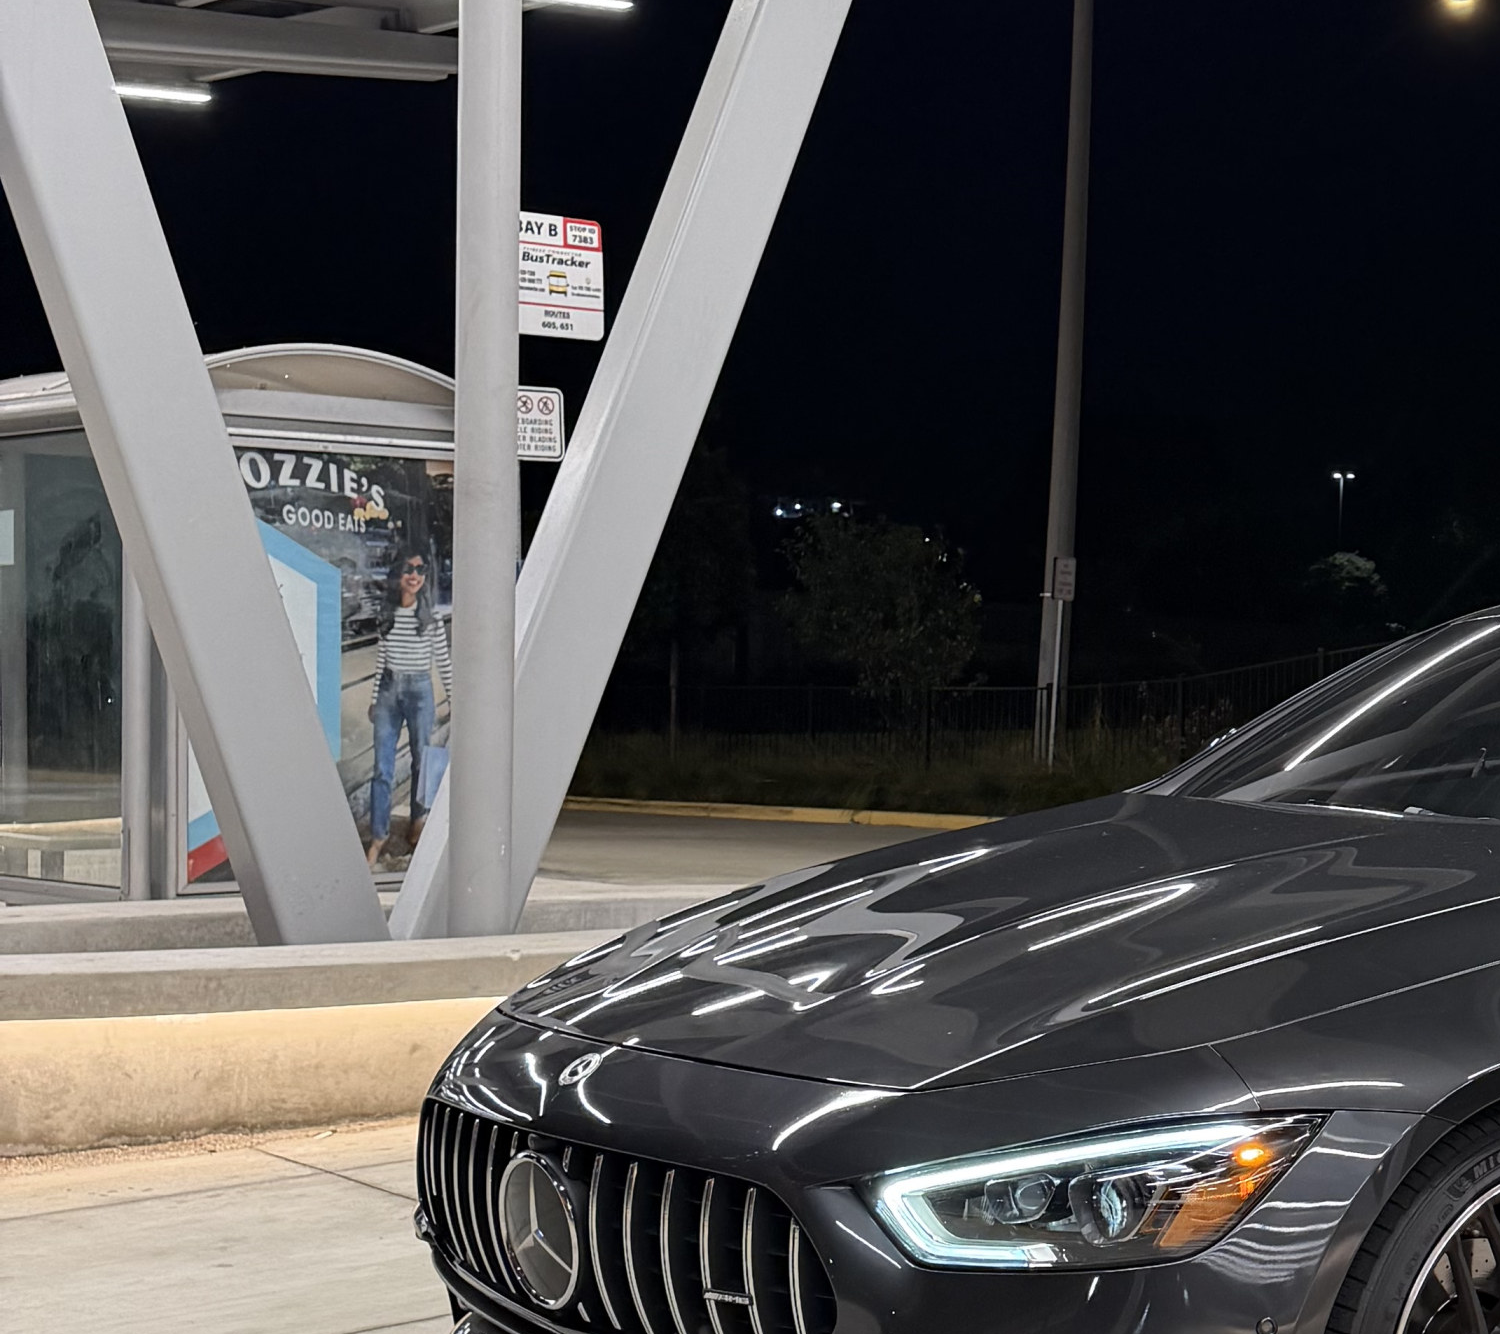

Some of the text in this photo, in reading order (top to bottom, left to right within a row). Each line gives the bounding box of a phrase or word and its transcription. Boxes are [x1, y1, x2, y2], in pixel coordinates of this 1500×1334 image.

[548, 223, 558, 237] B
[569, 225, 587, 233] STOP
[522, 251, 591, 269] BusTracker
[239, 451, 386, 511] OZZIE'S
[282, 504, 367, 534] GOOD EATS
